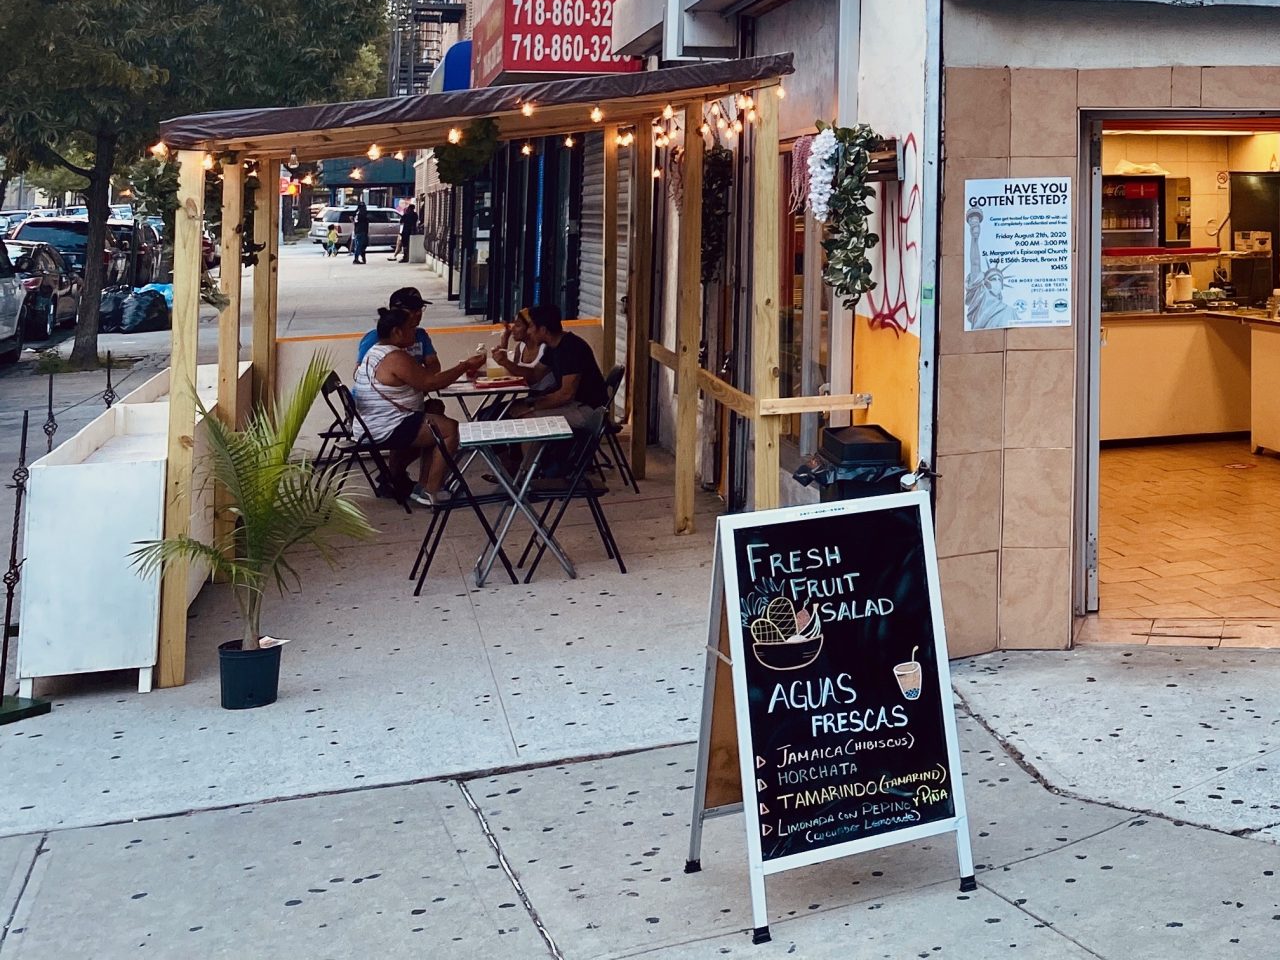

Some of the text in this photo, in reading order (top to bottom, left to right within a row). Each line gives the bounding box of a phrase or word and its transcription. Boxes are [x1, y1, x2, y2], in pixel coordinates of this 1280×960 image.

[511, 34, 632, 62] 718-860-32
[969, 194, 1068, 207] GOTTEN TESTED?
[1004, 183, 1068, 195] HAVE YOU
[1020, 248, 1046, 256] Episcopal
[746, 543, 842, 582] FRESH
[790, 572, 860, 601] FRUIT
[821, 598, 894, 622] SALAD
[768, 673, 857, 714] AGUAS
[811, 705, 909, 737] FRESCAS
[778, 762, 858, 786] HORCHATA
[778, 814, 834, 837] LIMONADA
[862, 801, 911, 815] PEPINO
